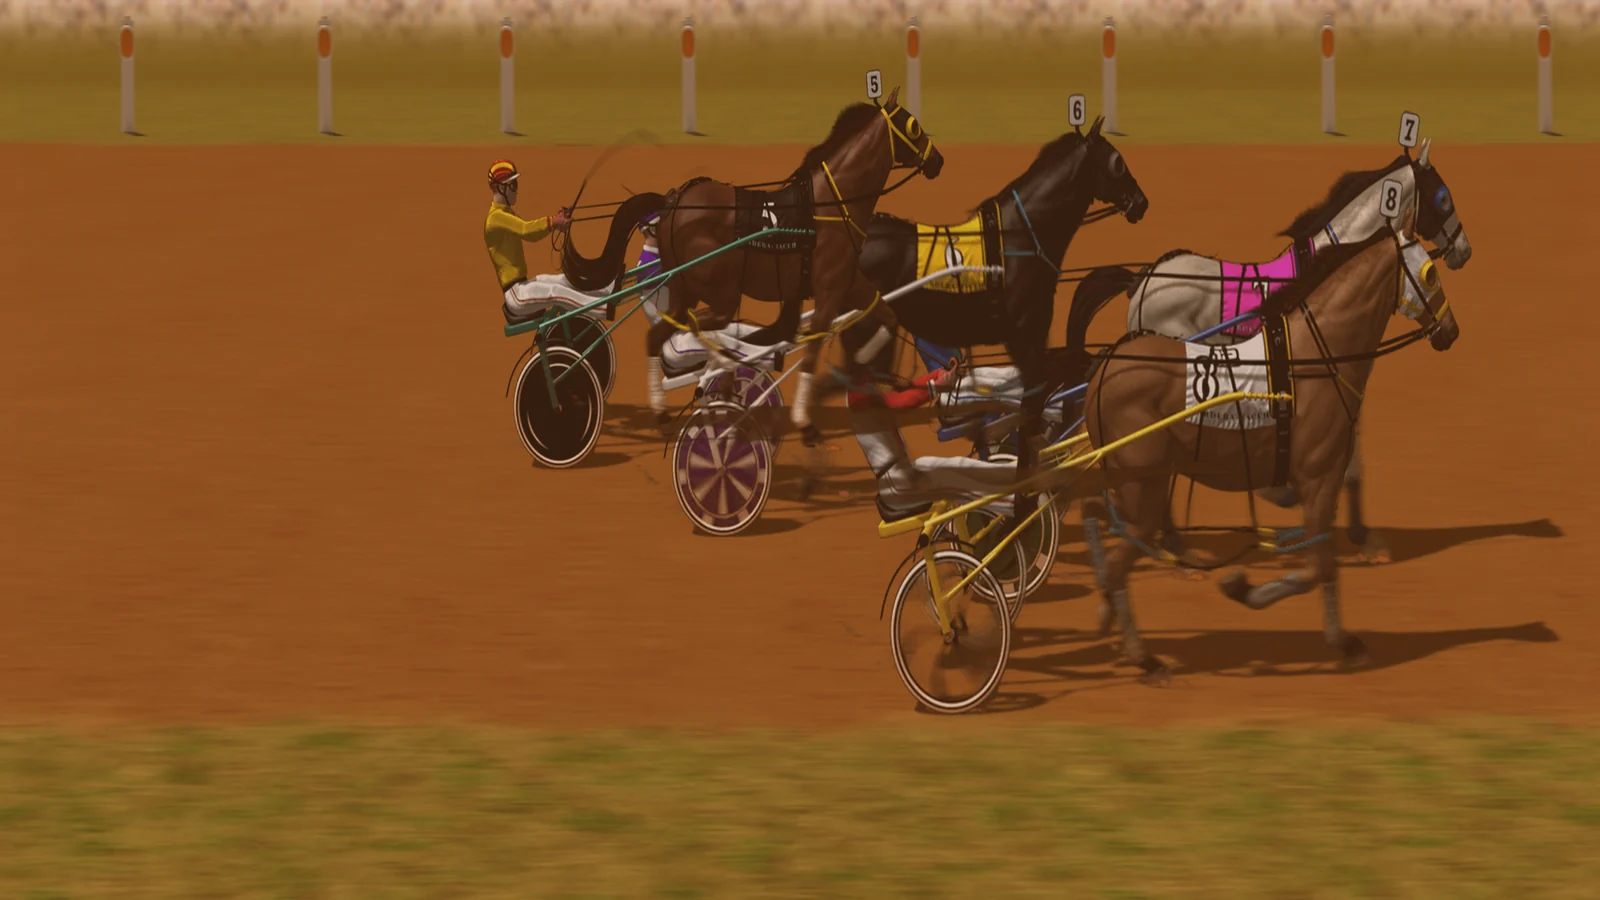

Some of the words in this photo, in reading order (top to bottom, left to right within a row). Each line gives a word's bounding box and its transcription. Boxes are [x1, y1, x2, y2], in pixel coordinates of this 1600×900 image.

[870, 75, 879, 93] 5
[1073, 100, 1082, 120] 6
[1405, 118, 1415, 141] 7
[1385, 187, 1397, 211] 8
[762, 202, 778, 231] 5
[1193, 355, 1219, 404] 8
